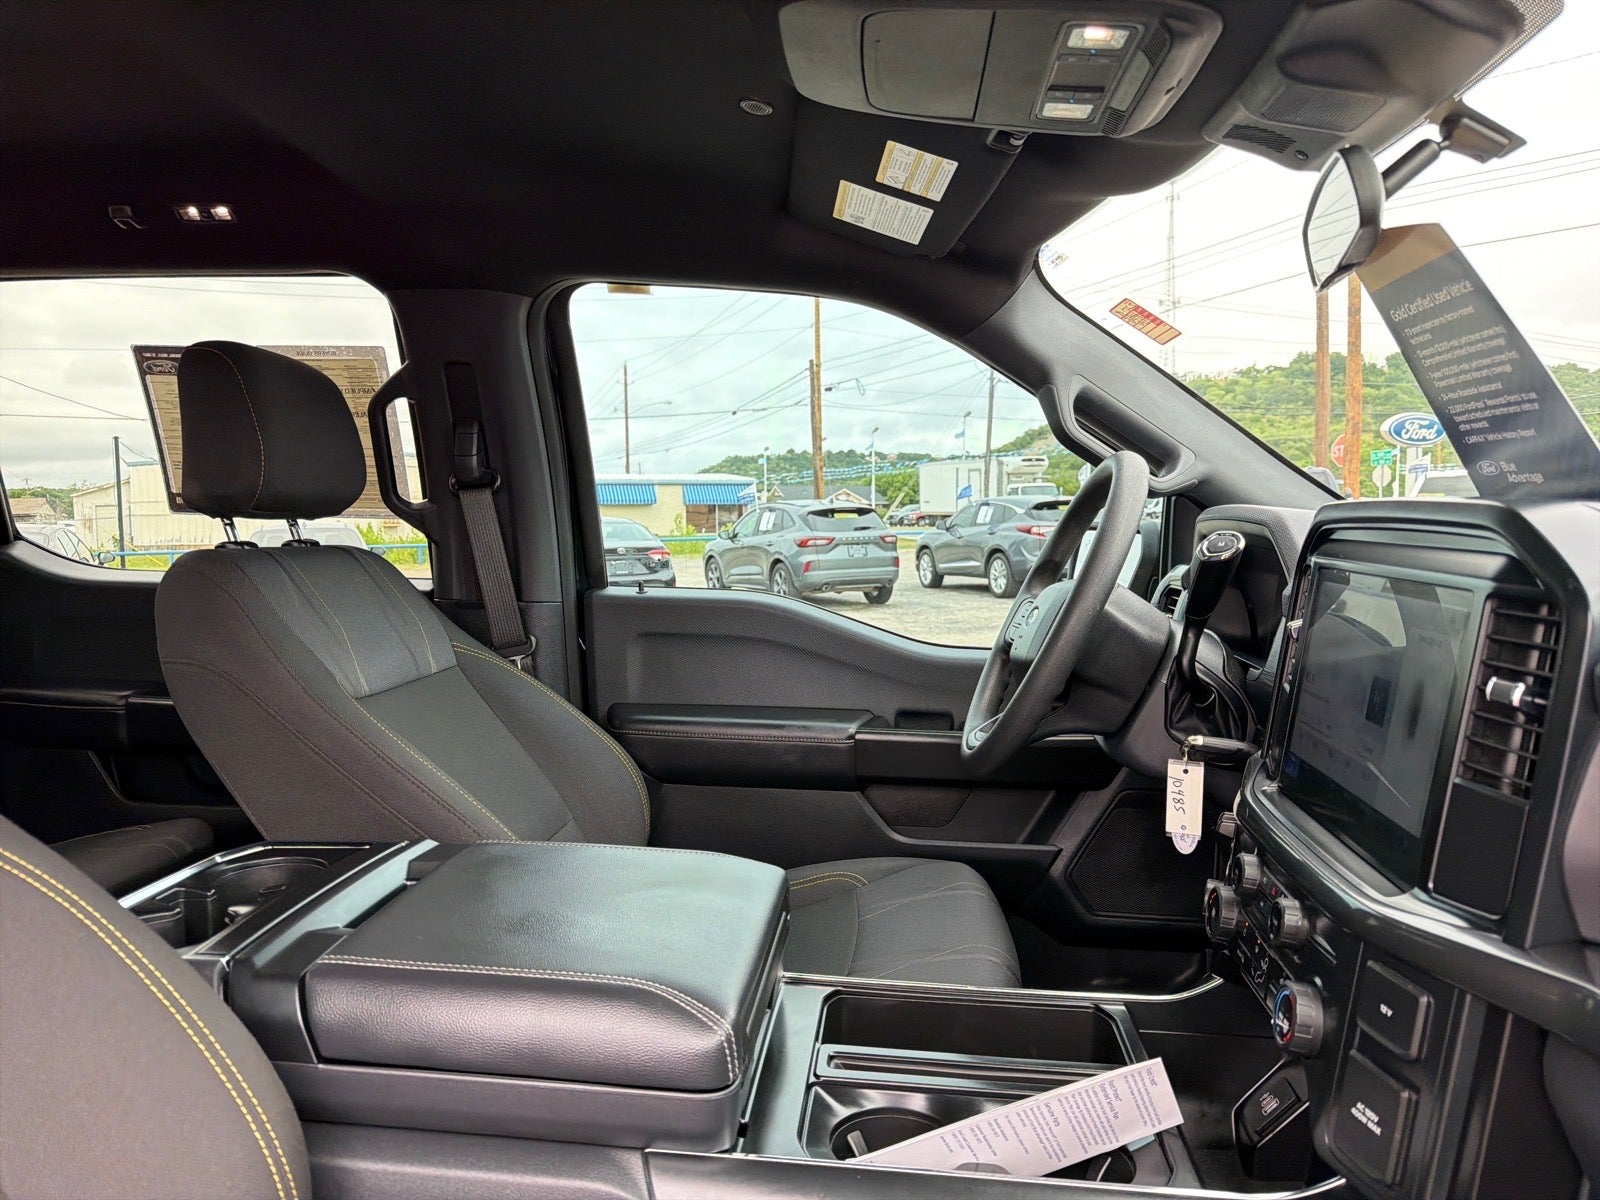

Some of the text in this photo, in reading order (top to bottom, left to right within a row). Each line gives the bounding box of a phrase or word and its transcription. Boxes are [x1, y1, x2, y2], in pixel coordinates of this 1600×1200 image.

[1390, 280, 1474, 321] Gold Certified Used Vehicle
[1401, 419, 1438, 440] Ford
[1333, 445, 1345, 457] ST
[1168, 776, 1186, 815] 10485
